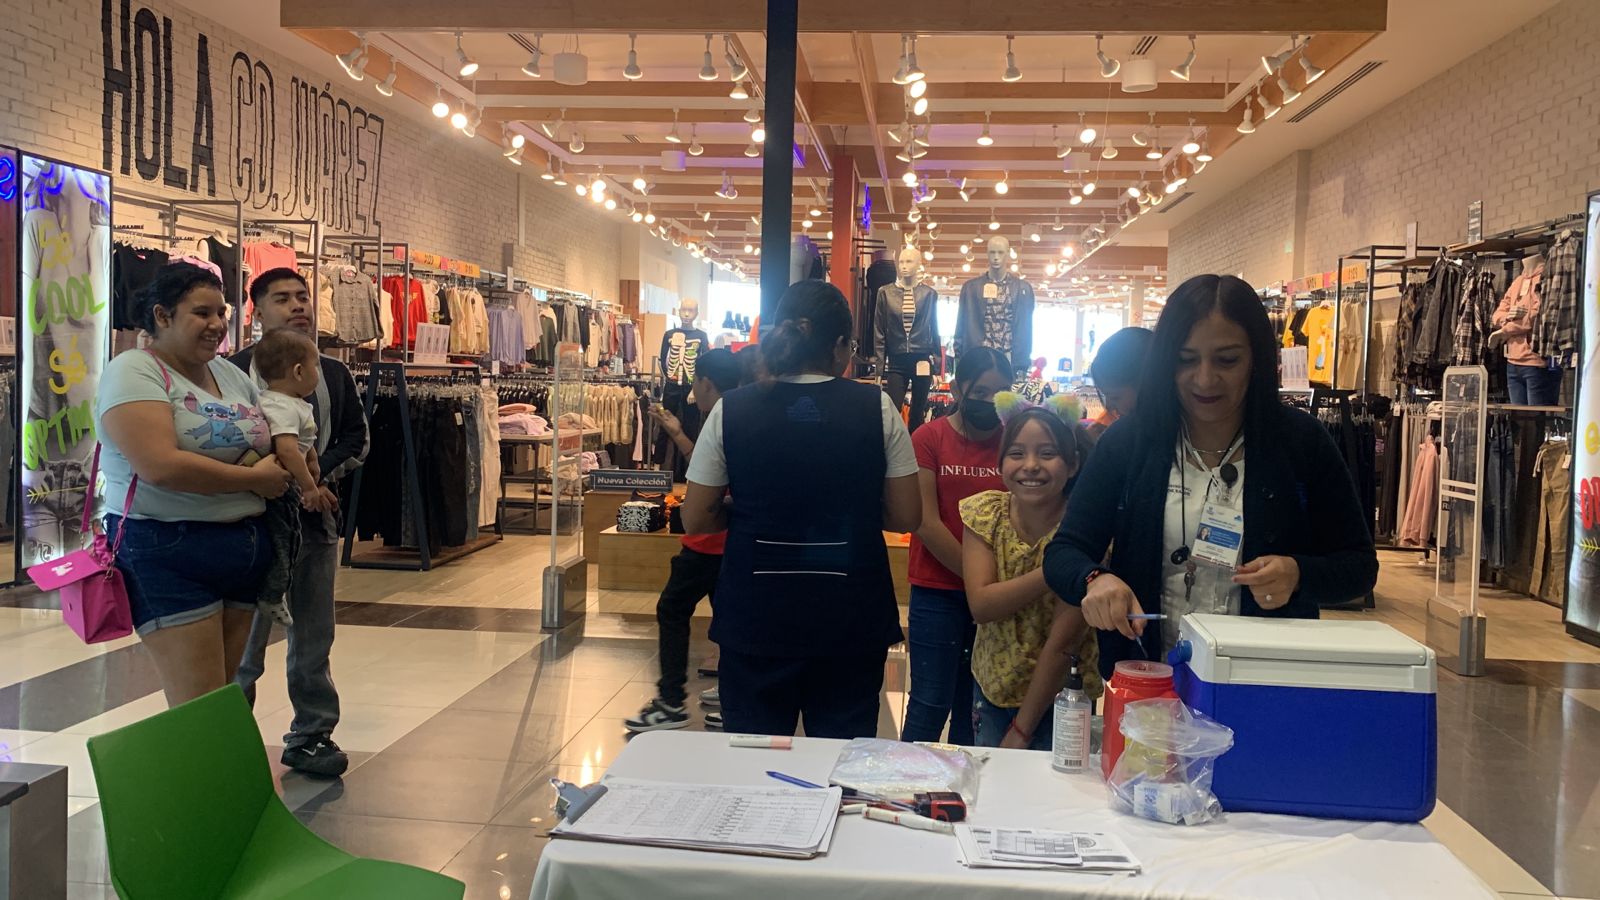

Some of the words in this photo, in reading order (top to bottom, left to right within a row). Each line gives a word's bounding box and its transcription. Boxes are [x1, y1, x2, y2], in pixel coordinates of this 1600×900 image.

[101, 0, 216, 197] HOLA
[28, 272, 105, 336] COOL
[23, 398, 97, 470] OPTIM
[597, 476, 624, 485] Nueva
[625, 477, 667, 486] Colección
